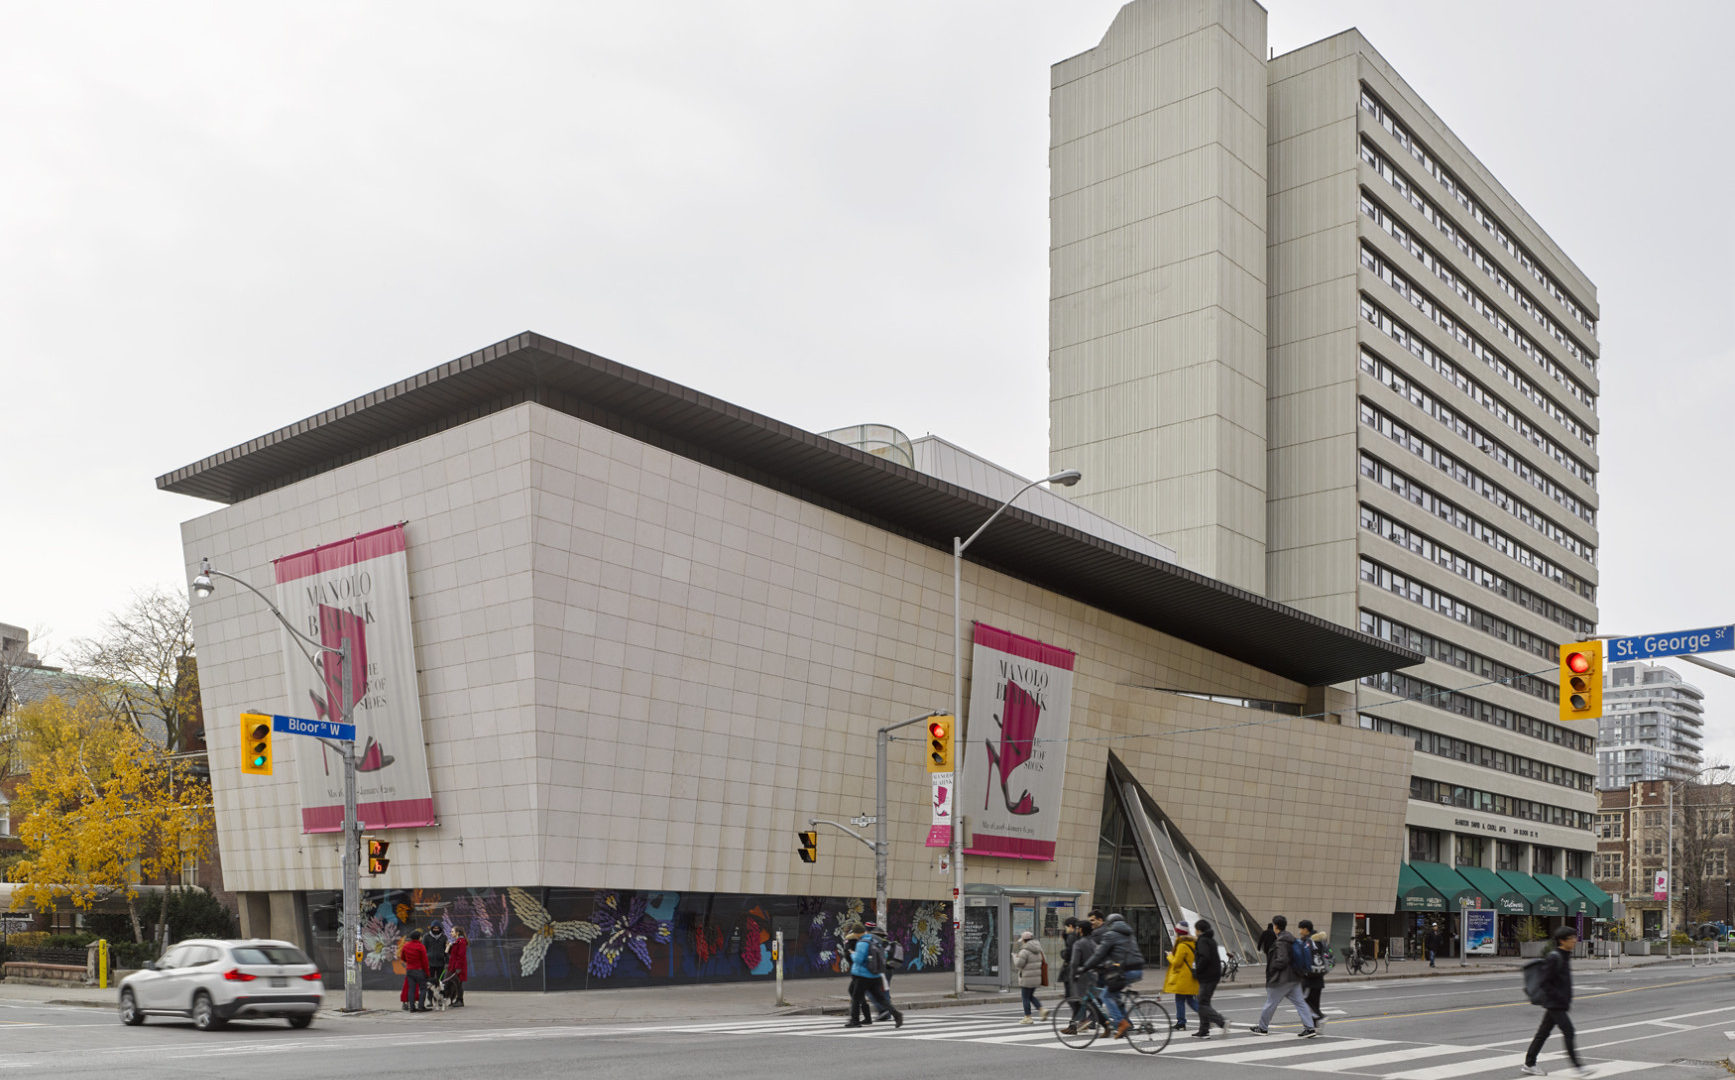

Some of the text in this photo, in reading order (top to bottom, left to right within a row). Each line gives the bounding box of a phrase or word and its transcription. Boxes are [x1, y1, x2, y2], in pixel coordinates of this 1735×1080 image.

[306, 571, 371, 607] MANOLO
[1616, 629, 1725, 656] St. George St
[1000, 659, 1048, 688] MANOLO
[288, 718, 319, 733] Bloor
[330, 724, 340, 736] W
